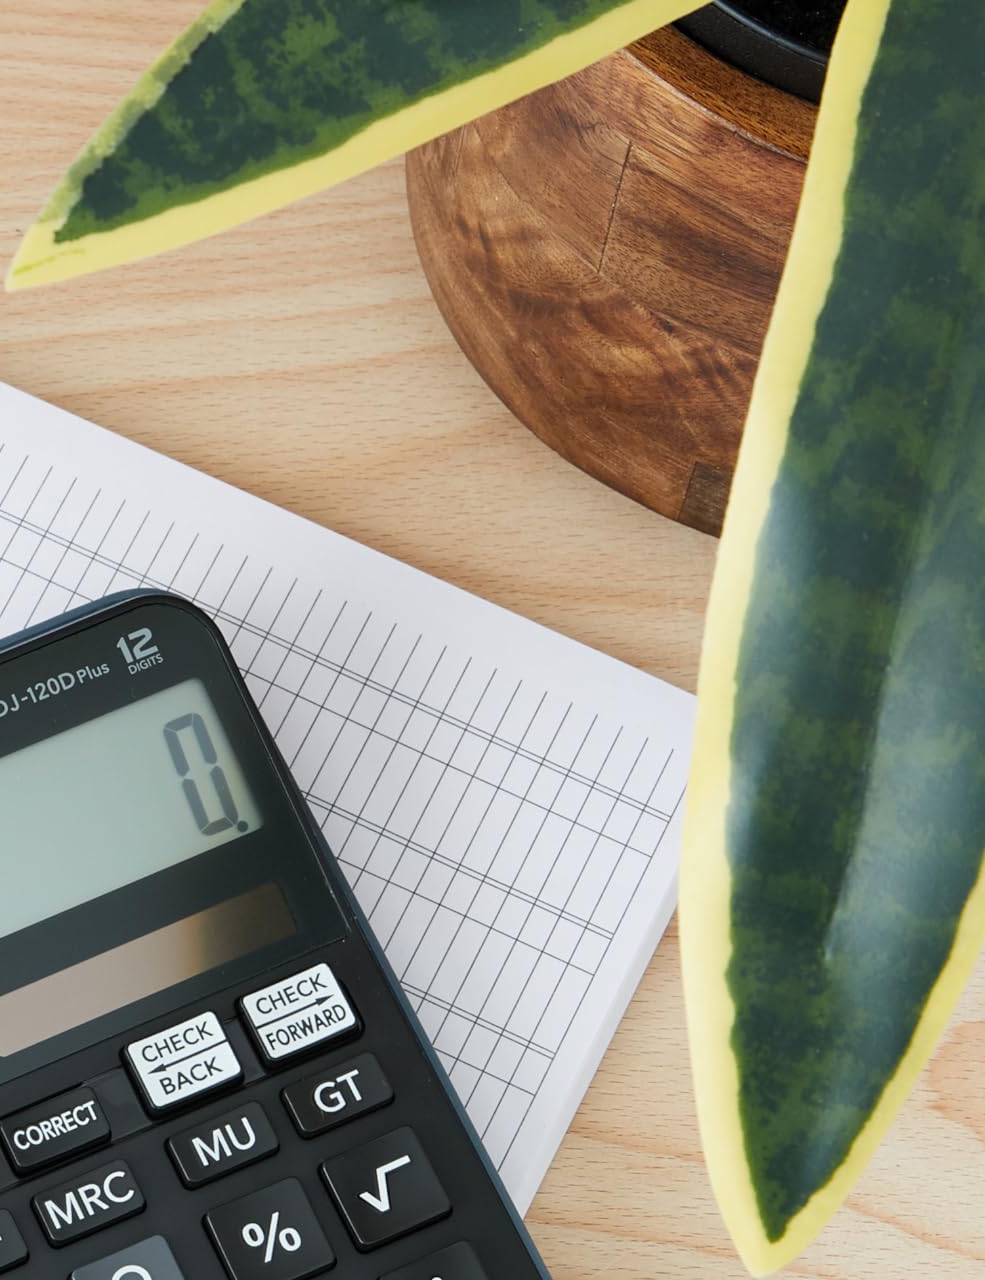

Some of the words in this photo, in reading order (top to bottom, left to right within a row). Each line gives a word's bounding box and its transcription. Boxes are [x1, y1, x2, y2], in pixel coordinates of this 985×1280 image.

[116, 627, 159, 664] 12
[128, 653, 164, 675] DIGITS
[76, 663, 110, 684] Plus
[255, 972, 328, 1016] CHECK
[141, 1021, 214, 1063] CHECK
[265, 1004, 348, 1051] FORWARD
[158, 1056, 223, 1095] BACK
[313, 1069, 363, 1114] GT
[13, 1100, 98, 1151] CORRECT
[191, 1117, 256, 1167] MU
[43, 1171, 135, 1229] MRC
[242, 1210, 302, 1264] %
